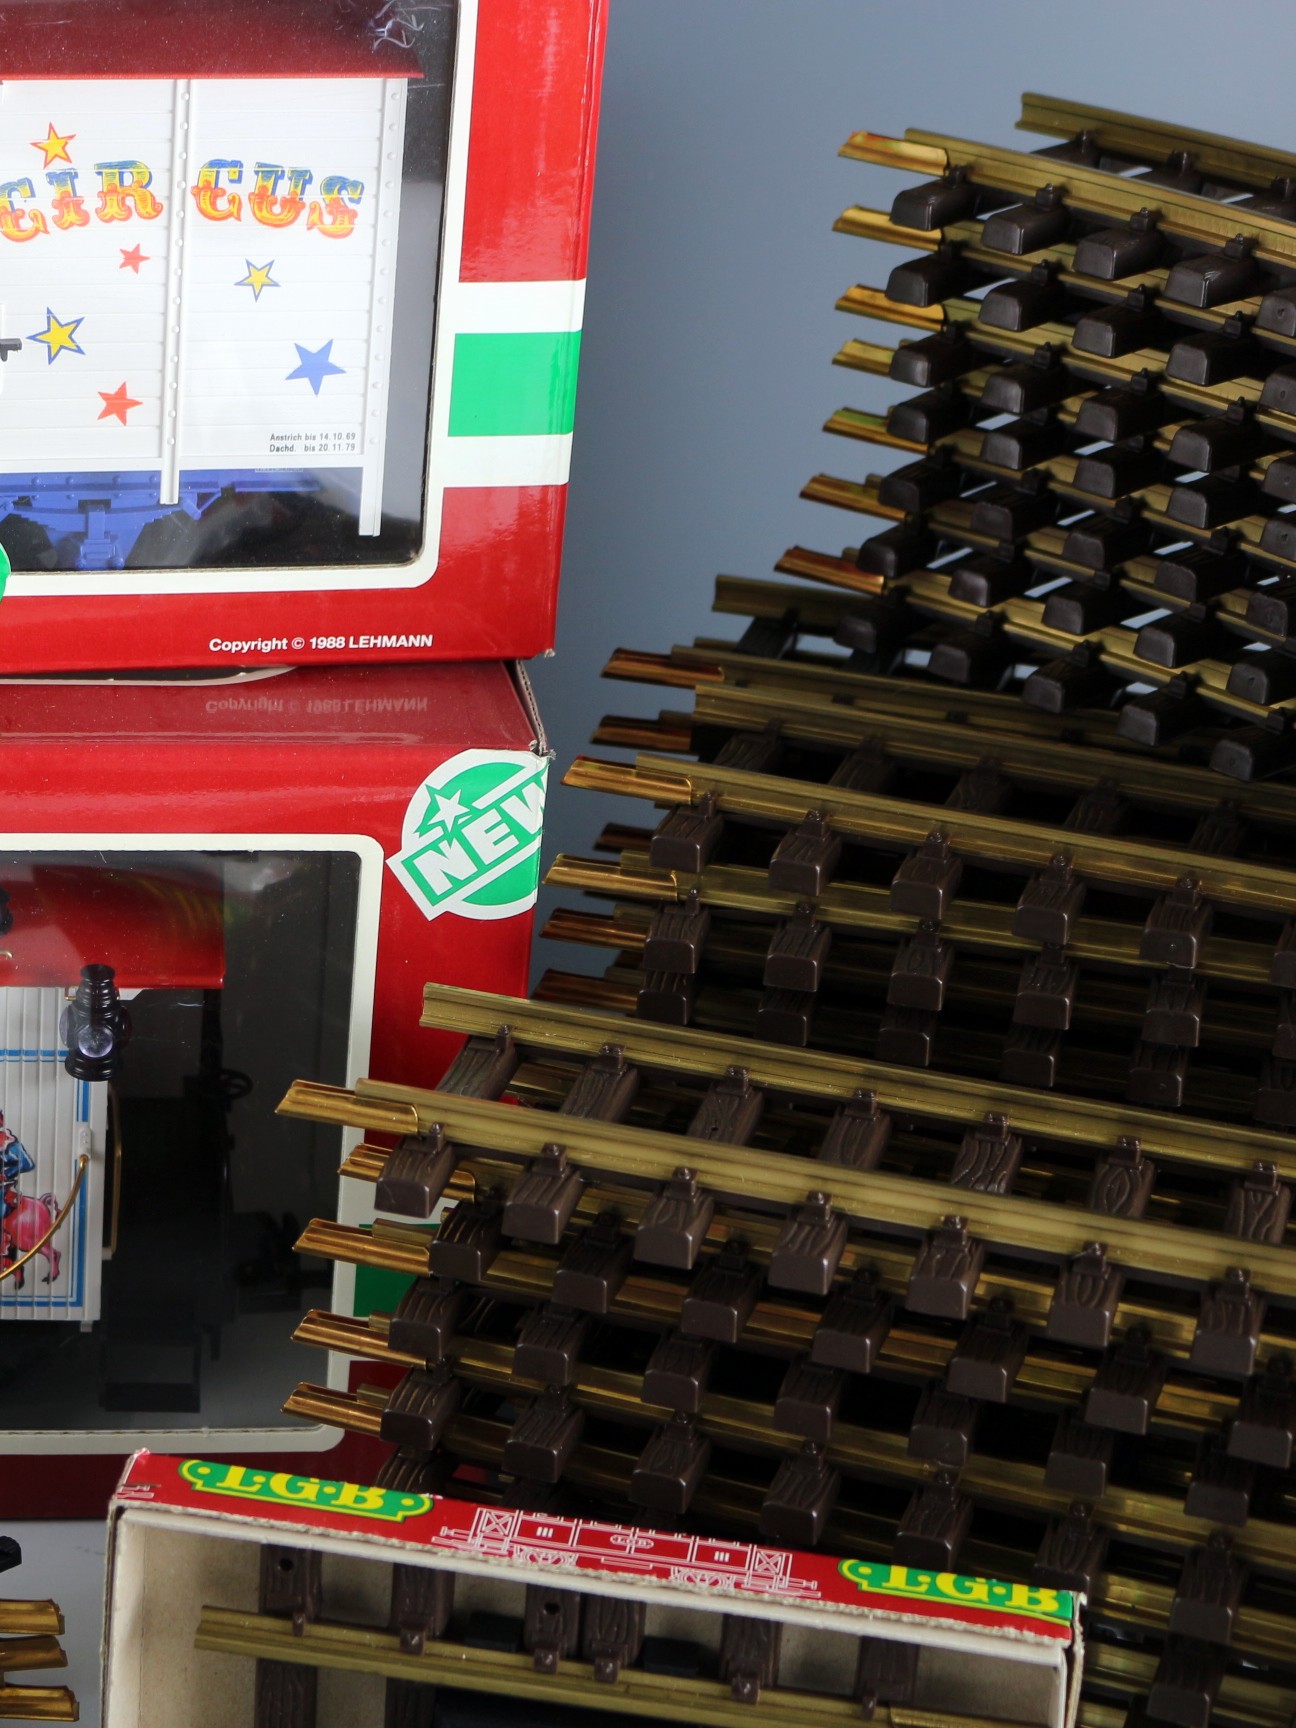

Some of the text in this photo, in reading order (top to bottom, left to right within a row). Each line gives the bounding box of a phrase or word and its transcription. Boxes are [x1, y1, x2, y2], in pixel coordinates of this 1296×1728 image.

[270, 433, 302, 441] Anstrich
[305, 433, 316, 441] bis
[269, 444, 296, 453] Dachd.
[304, 444, 315, 452] bis
[209, 637, 288, 653] Copyright
[309, 636, 346, 649] 1988
[348, 634, 433, 649] LEHMANN
